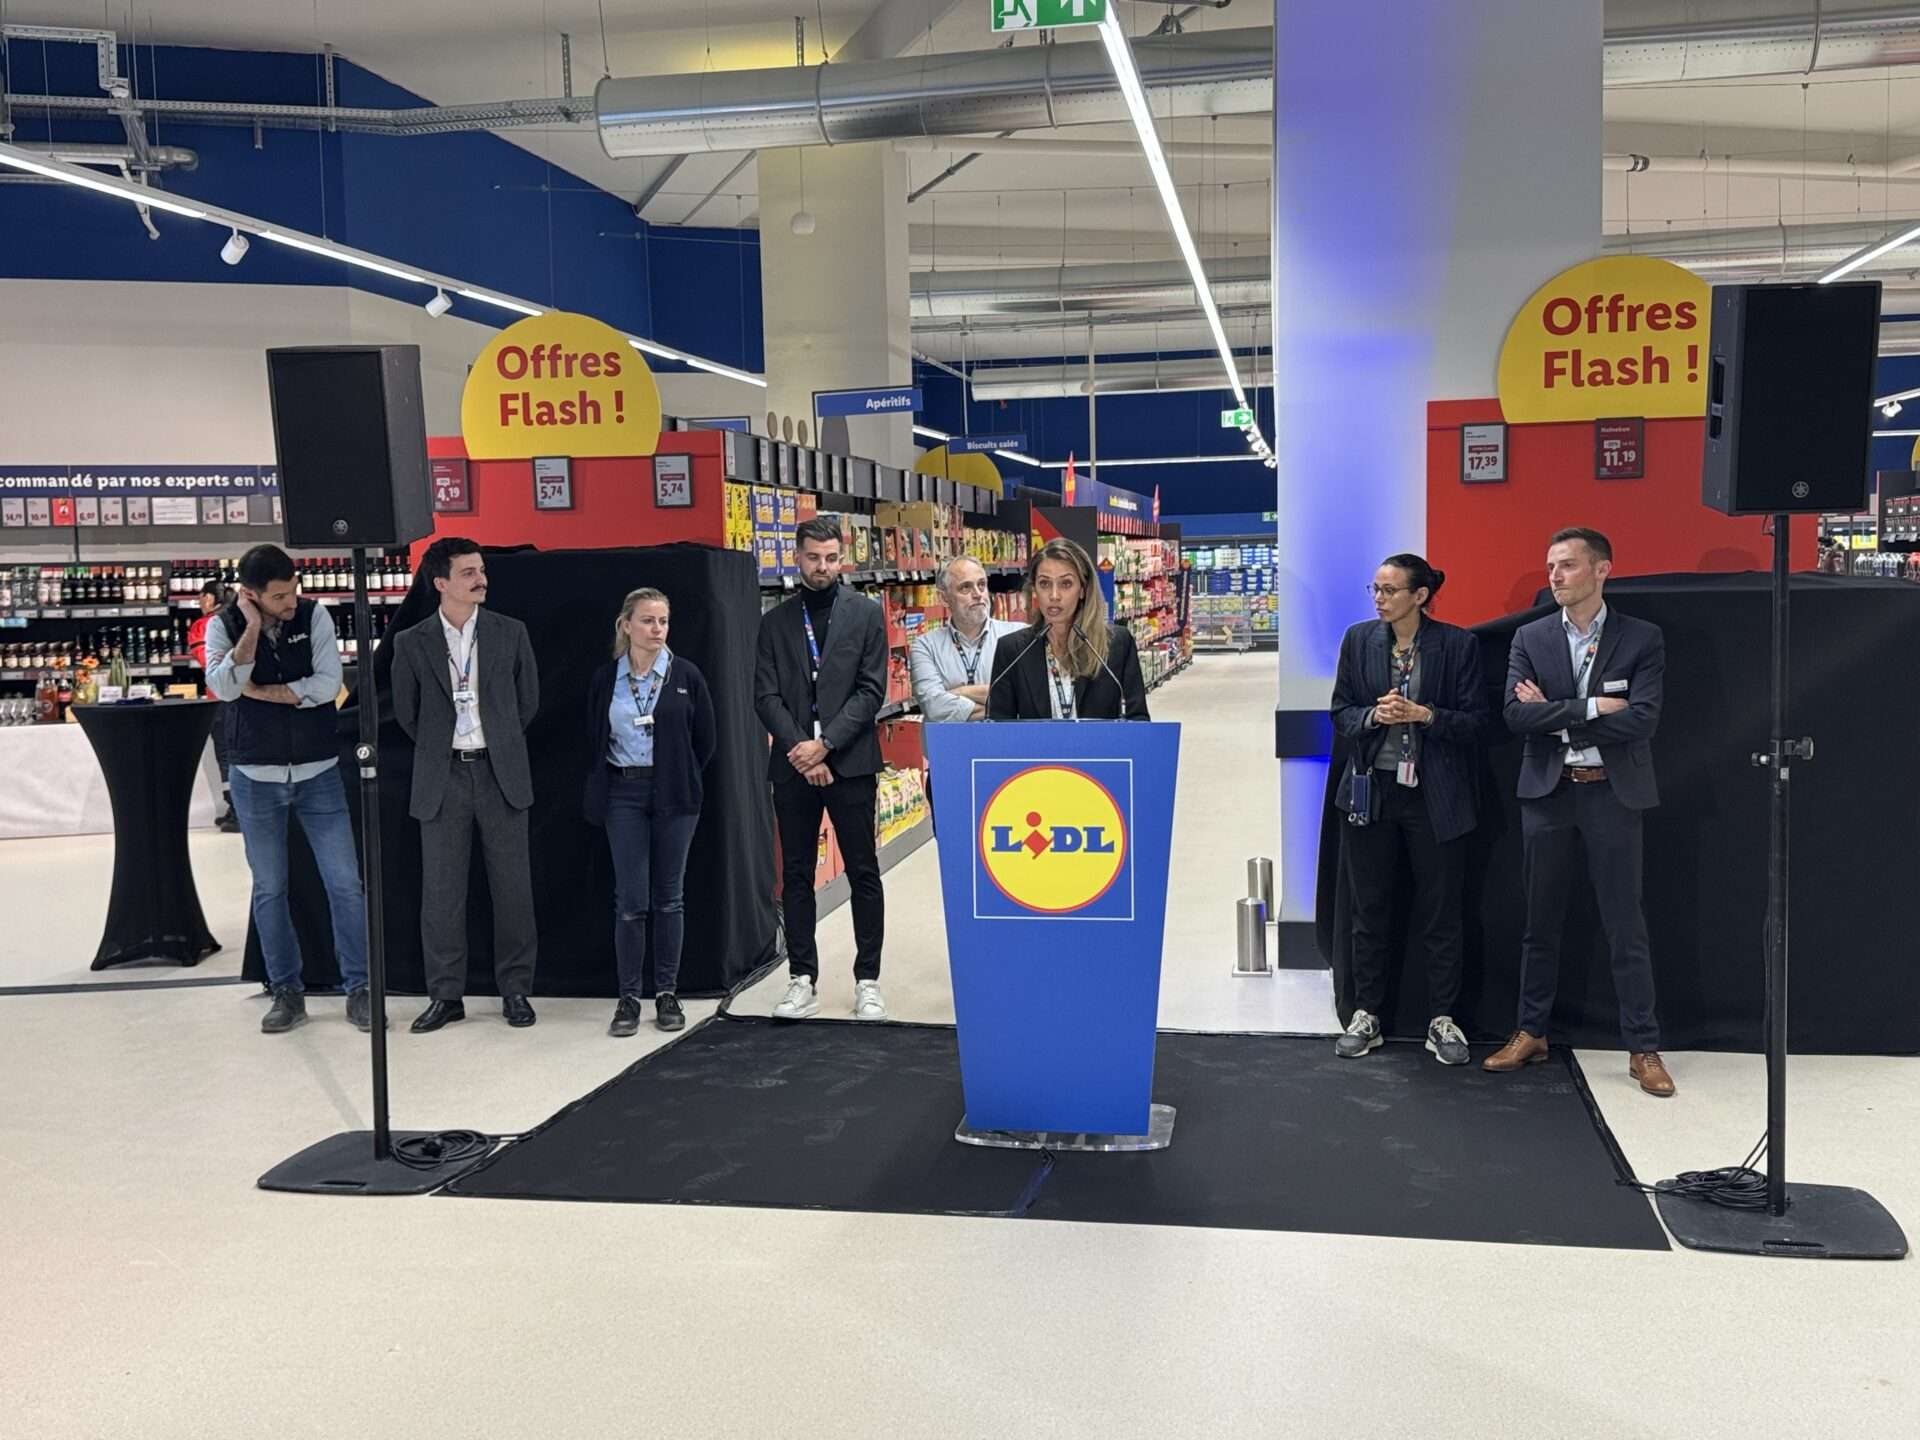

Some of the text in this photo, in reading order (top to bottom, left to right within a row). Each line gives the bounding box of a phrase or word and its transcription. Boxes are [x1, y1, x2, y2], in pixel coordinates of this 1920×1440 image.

[1542, 294, 1697, 336] Offres
[496, 343, 622, 380] Offres
[1543, 345, 1699, 389] Flash !
[499, 390, 625, 427] Flash !
[865, 396, 912, 411] Apéritifs
[966, 441, 997, 450] Biscuits
[1468, 456, 1498, 470] 17.39
[1603, 450, 1636, 466] 11.19
[0, 473, 93, 488] commandé
[97, 476, 128, 491] par
[130, 476, 161, 487] nos
[165, 474, 229, 490] experts
[233, 476, 255, 487] en
[660, 482, 684, 497] 5.74
[437, 487, 460, 502] 4.19
[540, 485, 563, 500] 5.74
